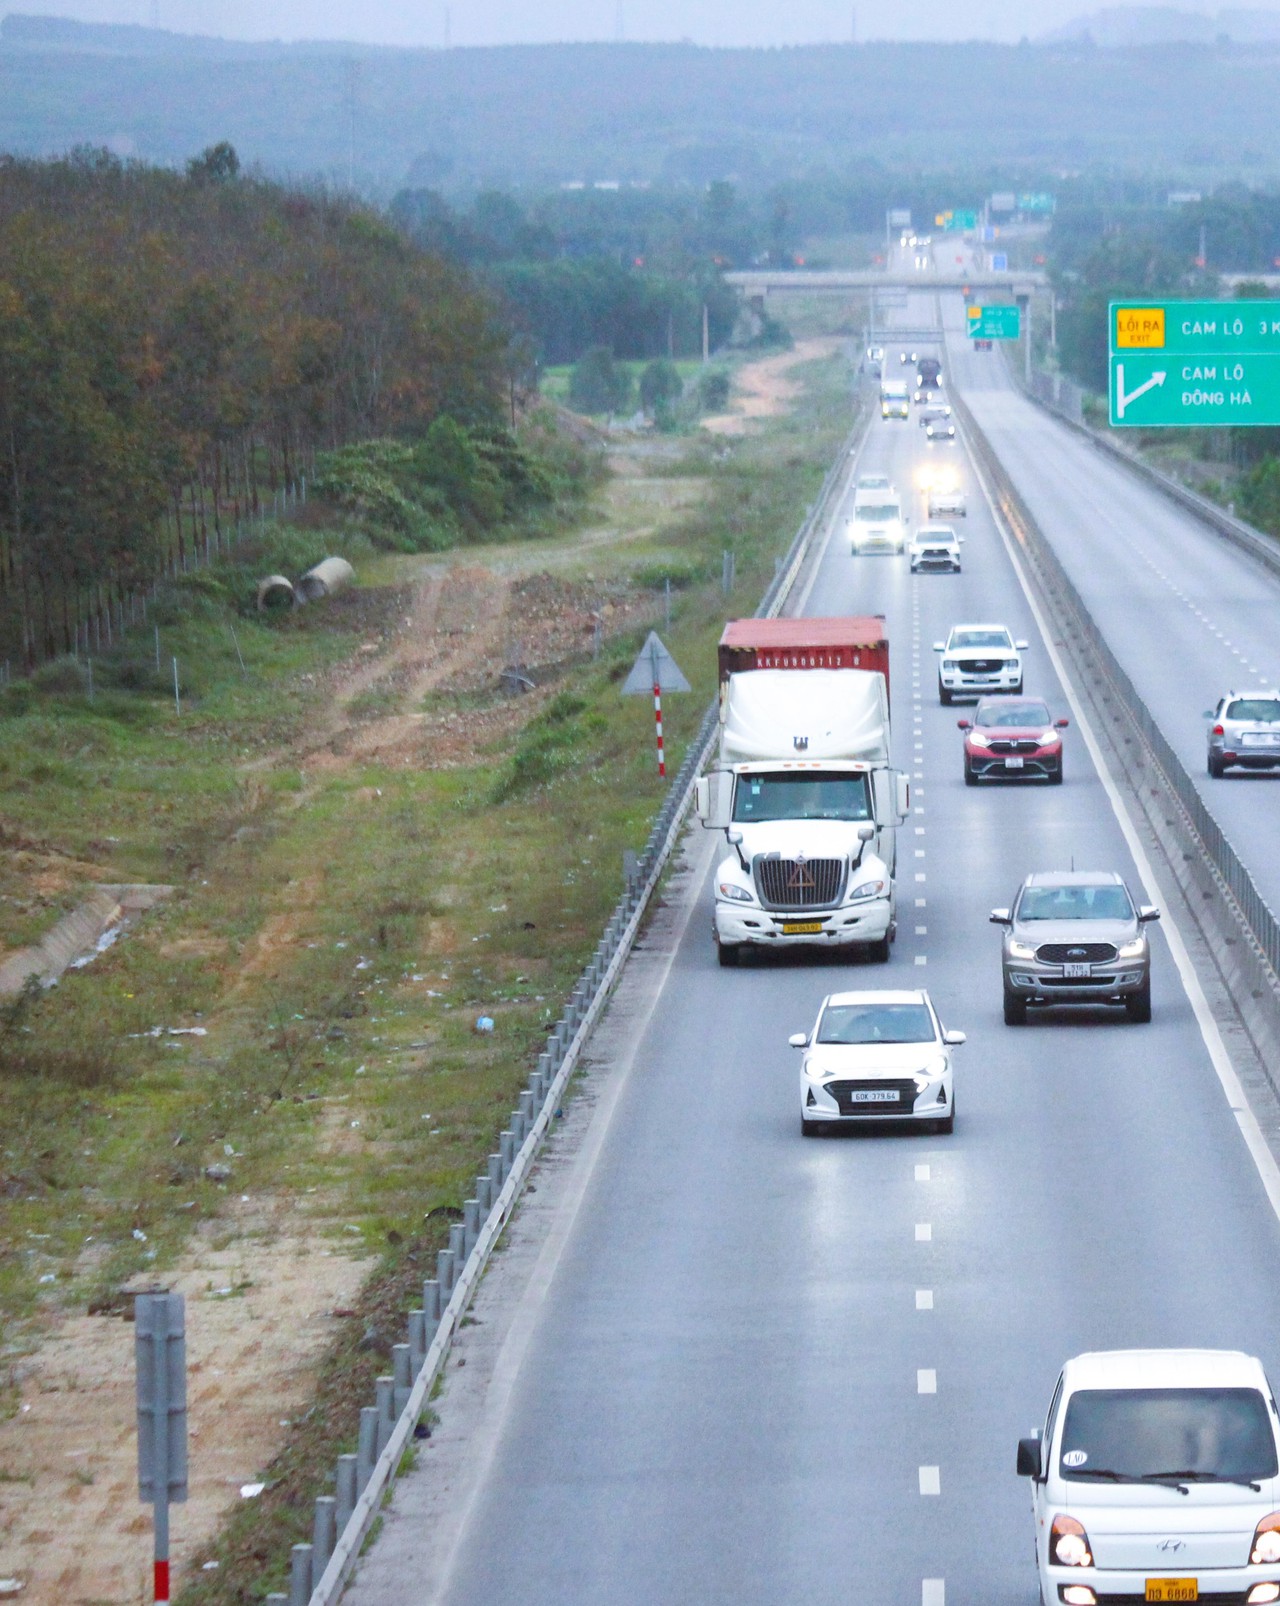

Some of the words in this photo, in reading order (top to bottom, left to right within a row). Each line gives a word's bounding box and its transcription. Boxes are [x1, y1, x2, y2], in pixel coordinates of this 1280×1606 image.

[1143, 320, 1160, 332] RA
[1181, 321, 1216, 335] CAM
[1130, 335, 1150, 343] EXIT
[1181, 366, 1216, 381] CAM
[1181, 388, 1225, 406] ĐÔNG
[1230, 387, 1253, 405] HÀ
